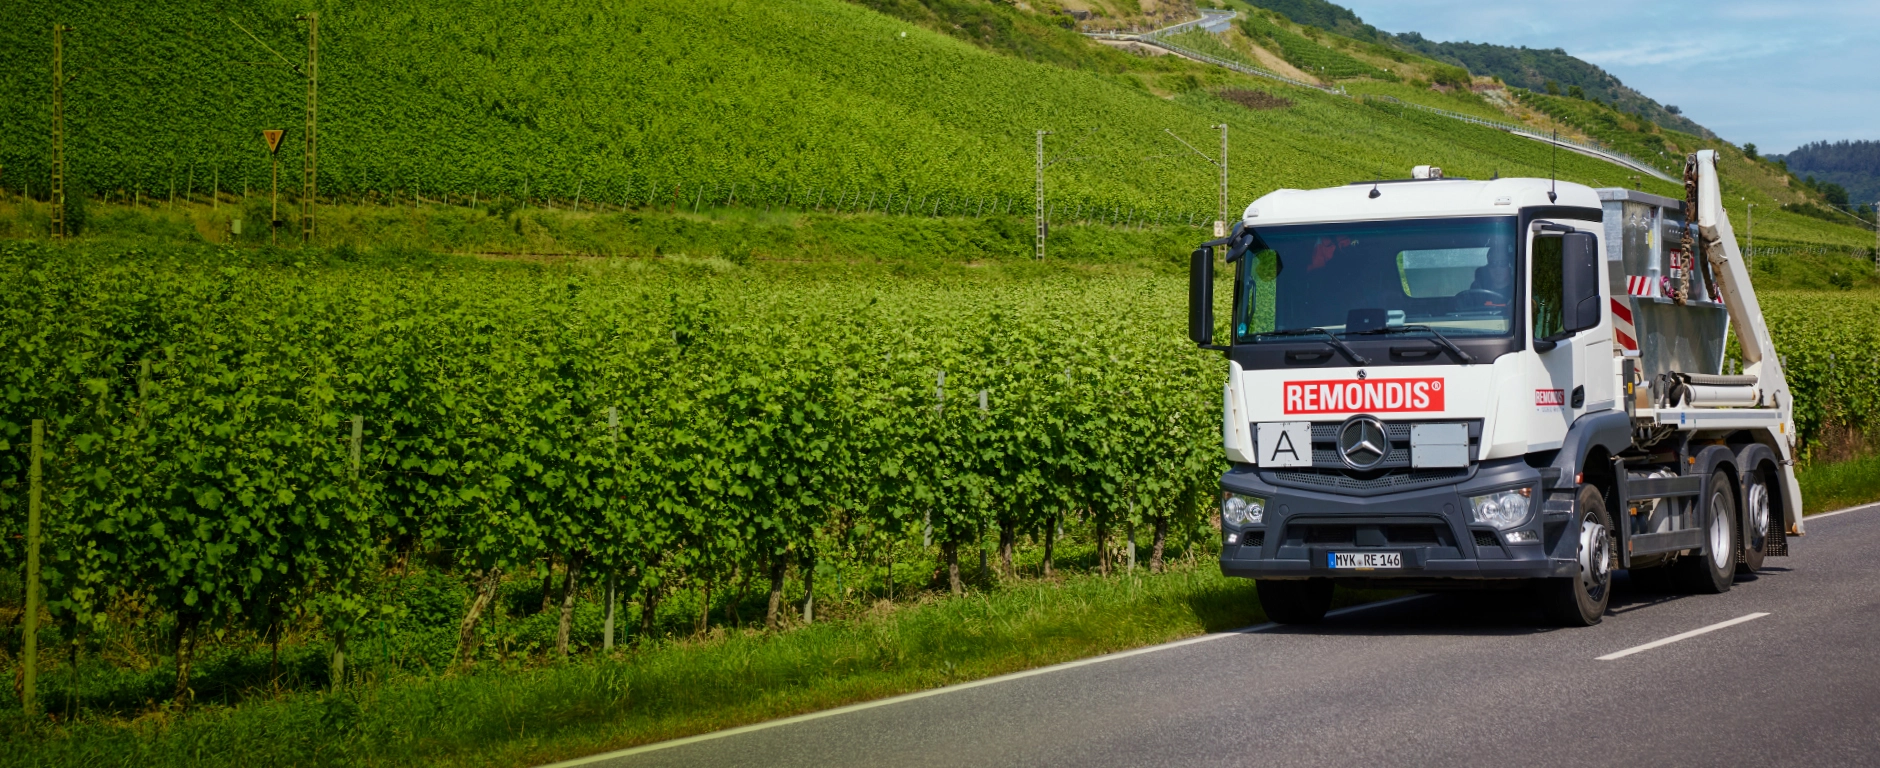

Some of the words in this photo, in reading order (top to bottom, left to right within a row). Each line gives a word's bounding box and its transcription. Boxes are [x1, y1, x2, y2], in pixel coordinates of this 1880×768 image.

[1271, 430, 1300, 461] A
[1336, 554, 1356, 567] MYK
[1364, 554, 1377, 567] RE
[1380, 554, 1400, 567] 146
